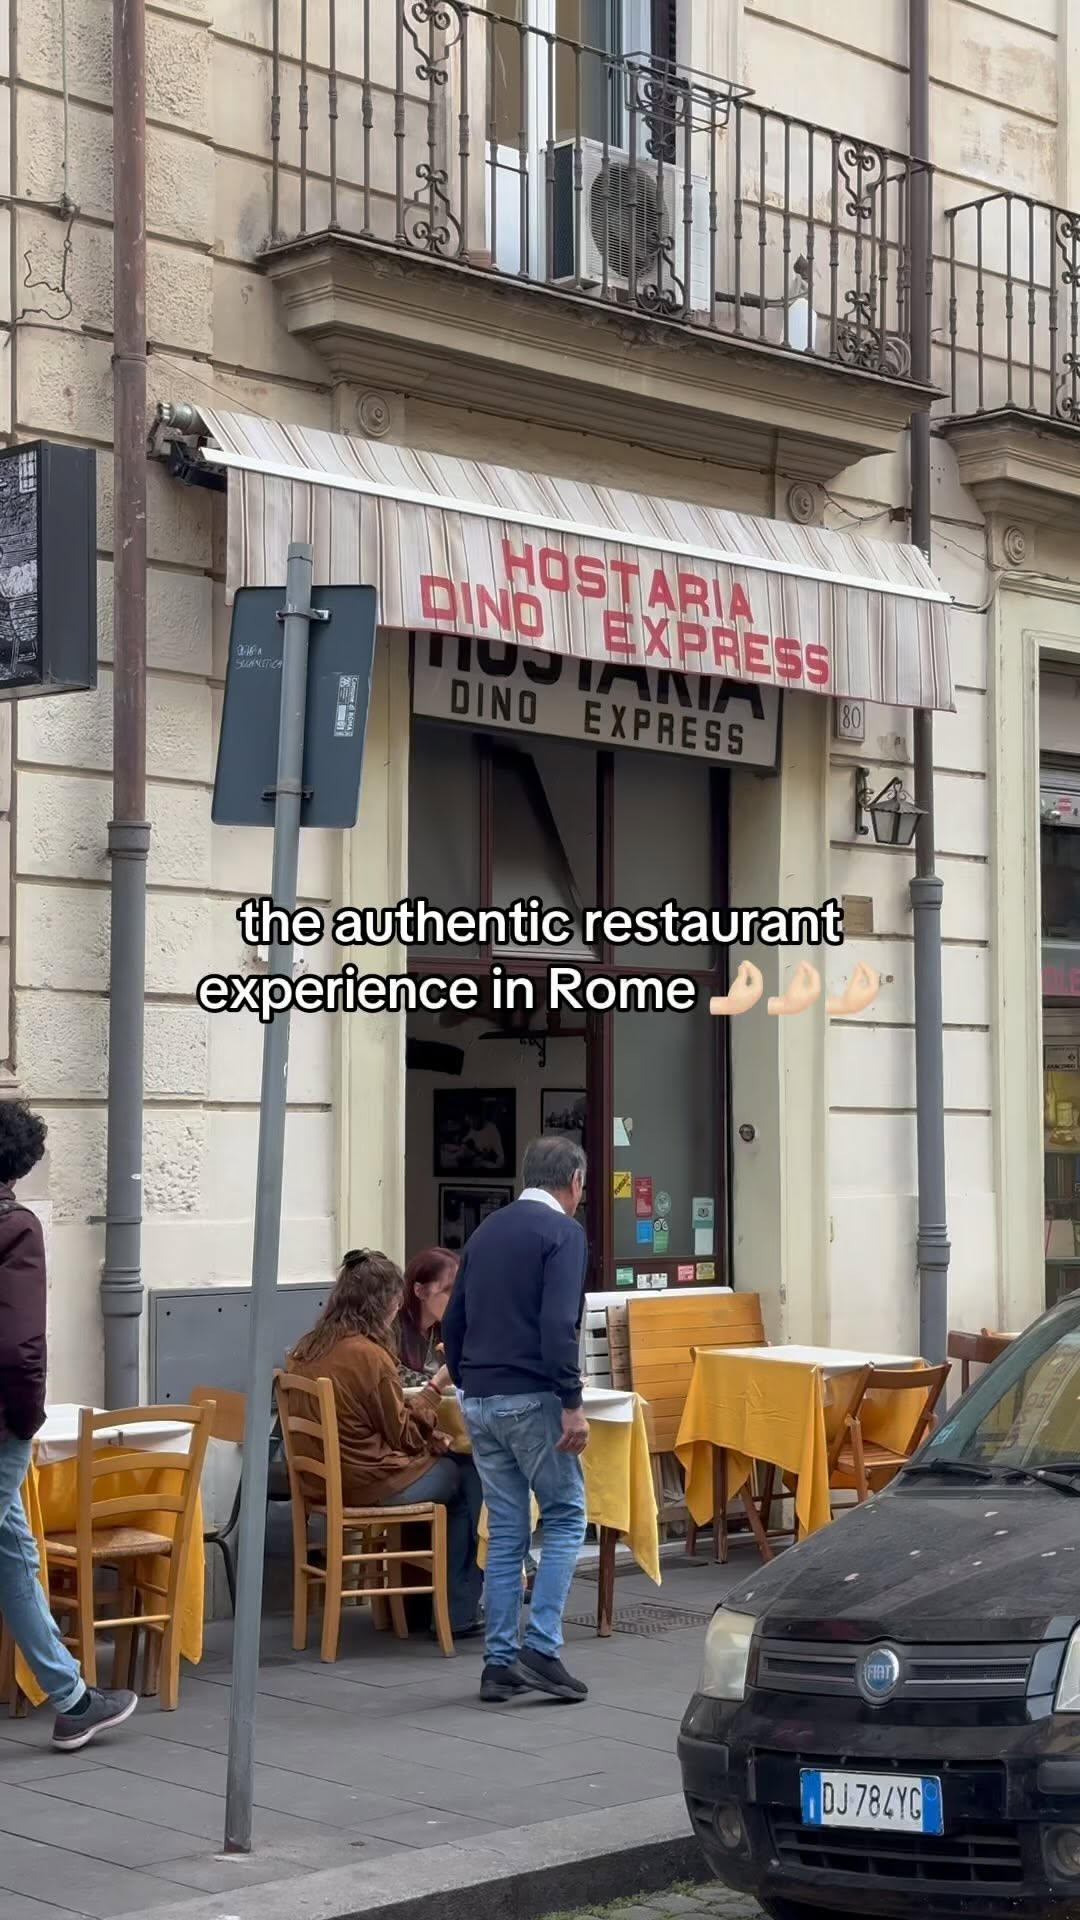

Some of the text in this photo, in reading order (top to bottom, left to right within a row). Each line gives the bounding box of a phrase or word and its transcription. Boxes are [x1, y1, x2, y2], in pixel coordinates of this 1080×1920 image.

[502, 539, 754, 624] HOSTARIA
[420, 575, 829, 685] DINO EXPRESS
[451, 679, 744, 755] DINO EXPRESS
[842, 704, 861, 729] 80
[867, 1664, 893, 1680] FIAT
